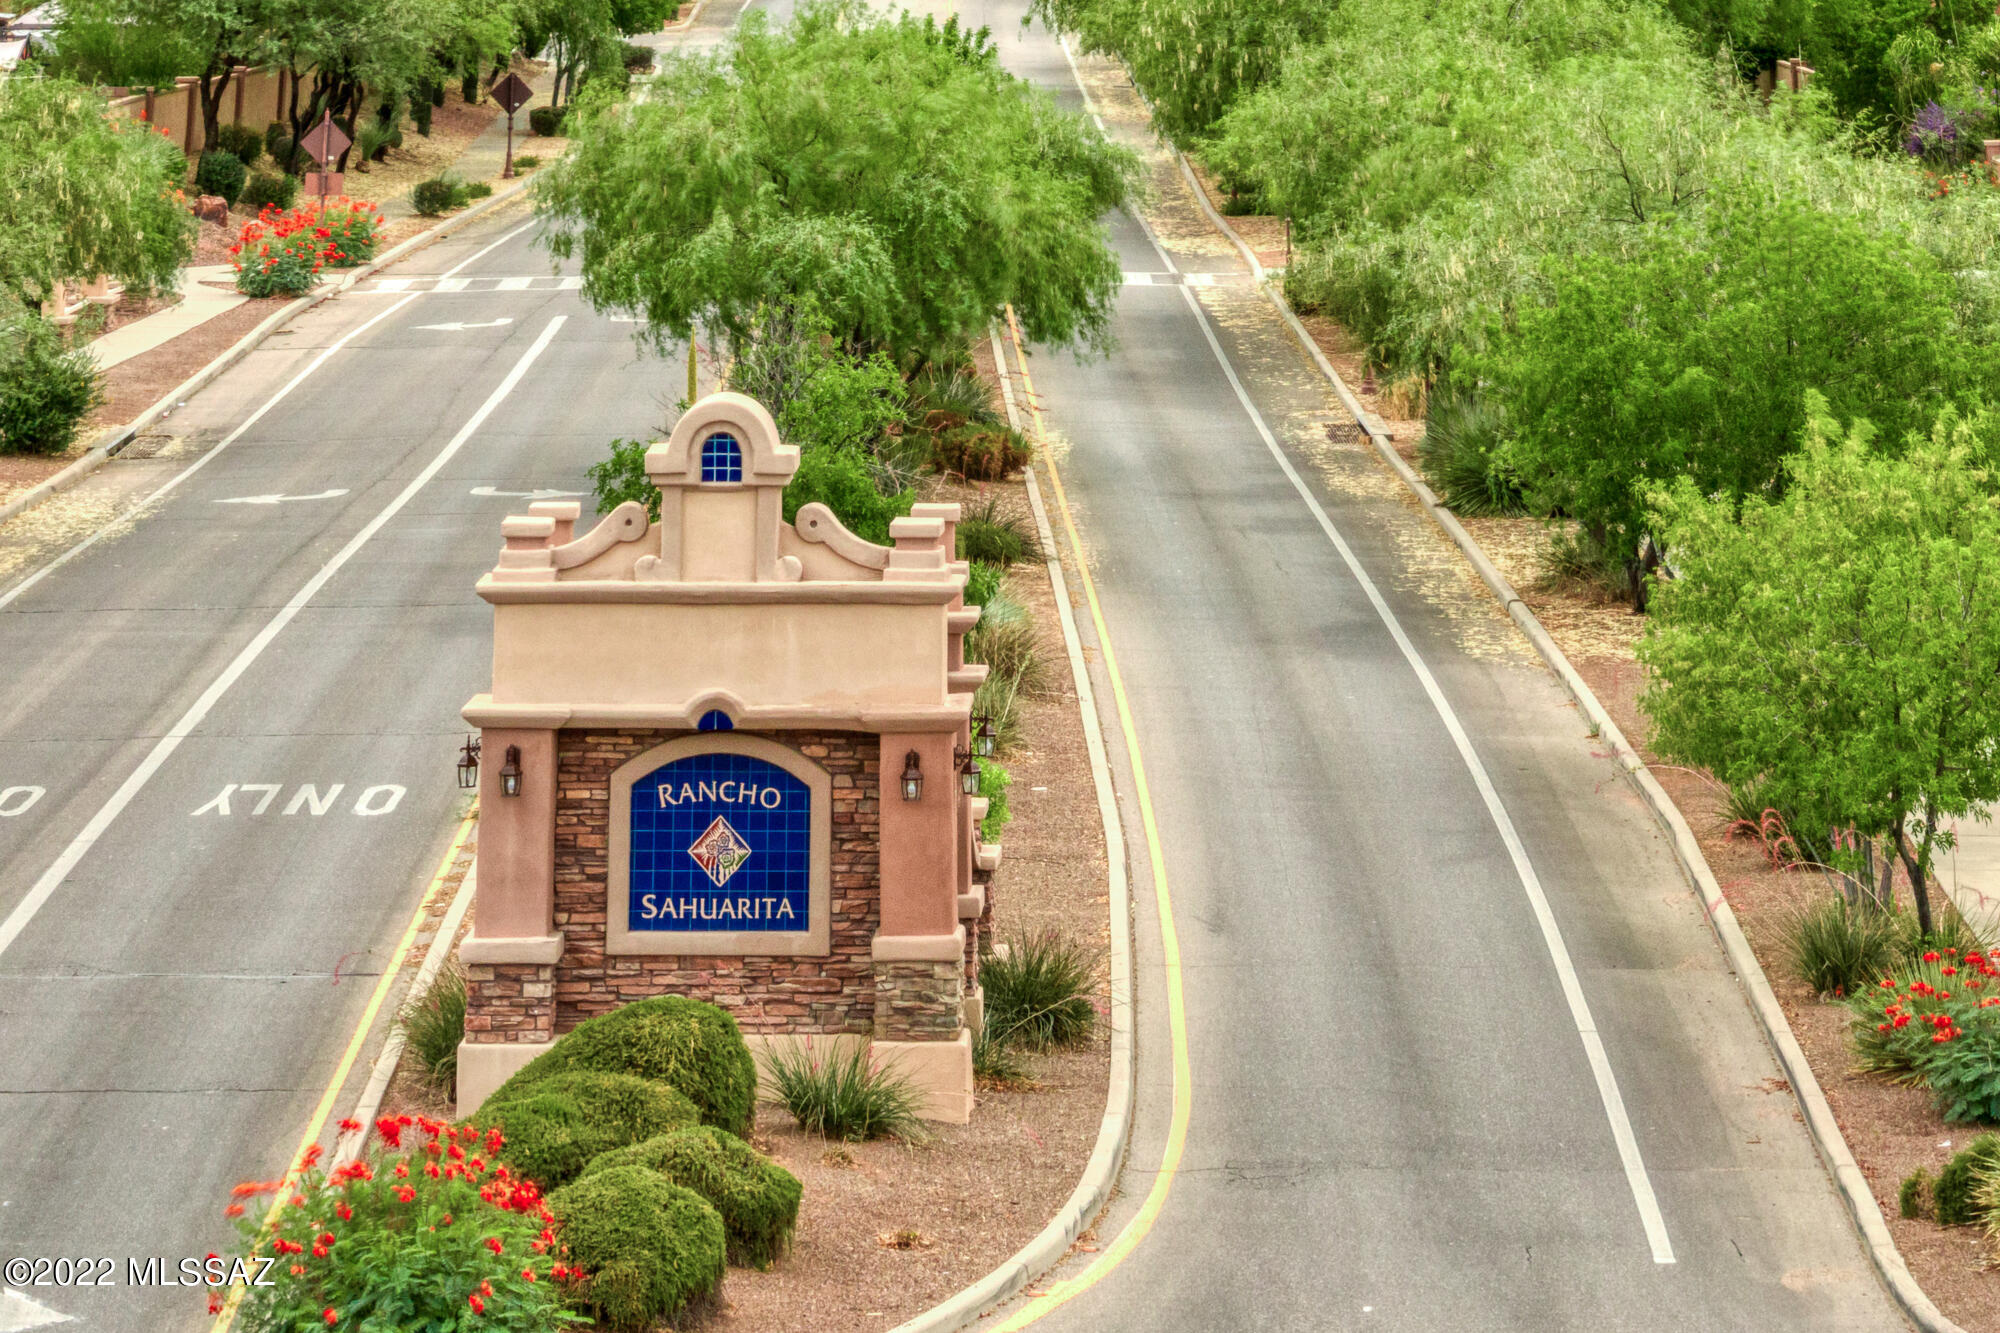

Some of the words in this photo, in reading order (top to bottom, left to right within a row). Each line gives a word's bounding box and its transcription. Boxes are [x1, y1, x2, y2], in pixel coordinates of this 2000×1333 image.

[190, 784, 407, 816] ONLY
[658, 781, 781, 808] RANCHO
[641, 894, 795, 919] SAHUARITA
